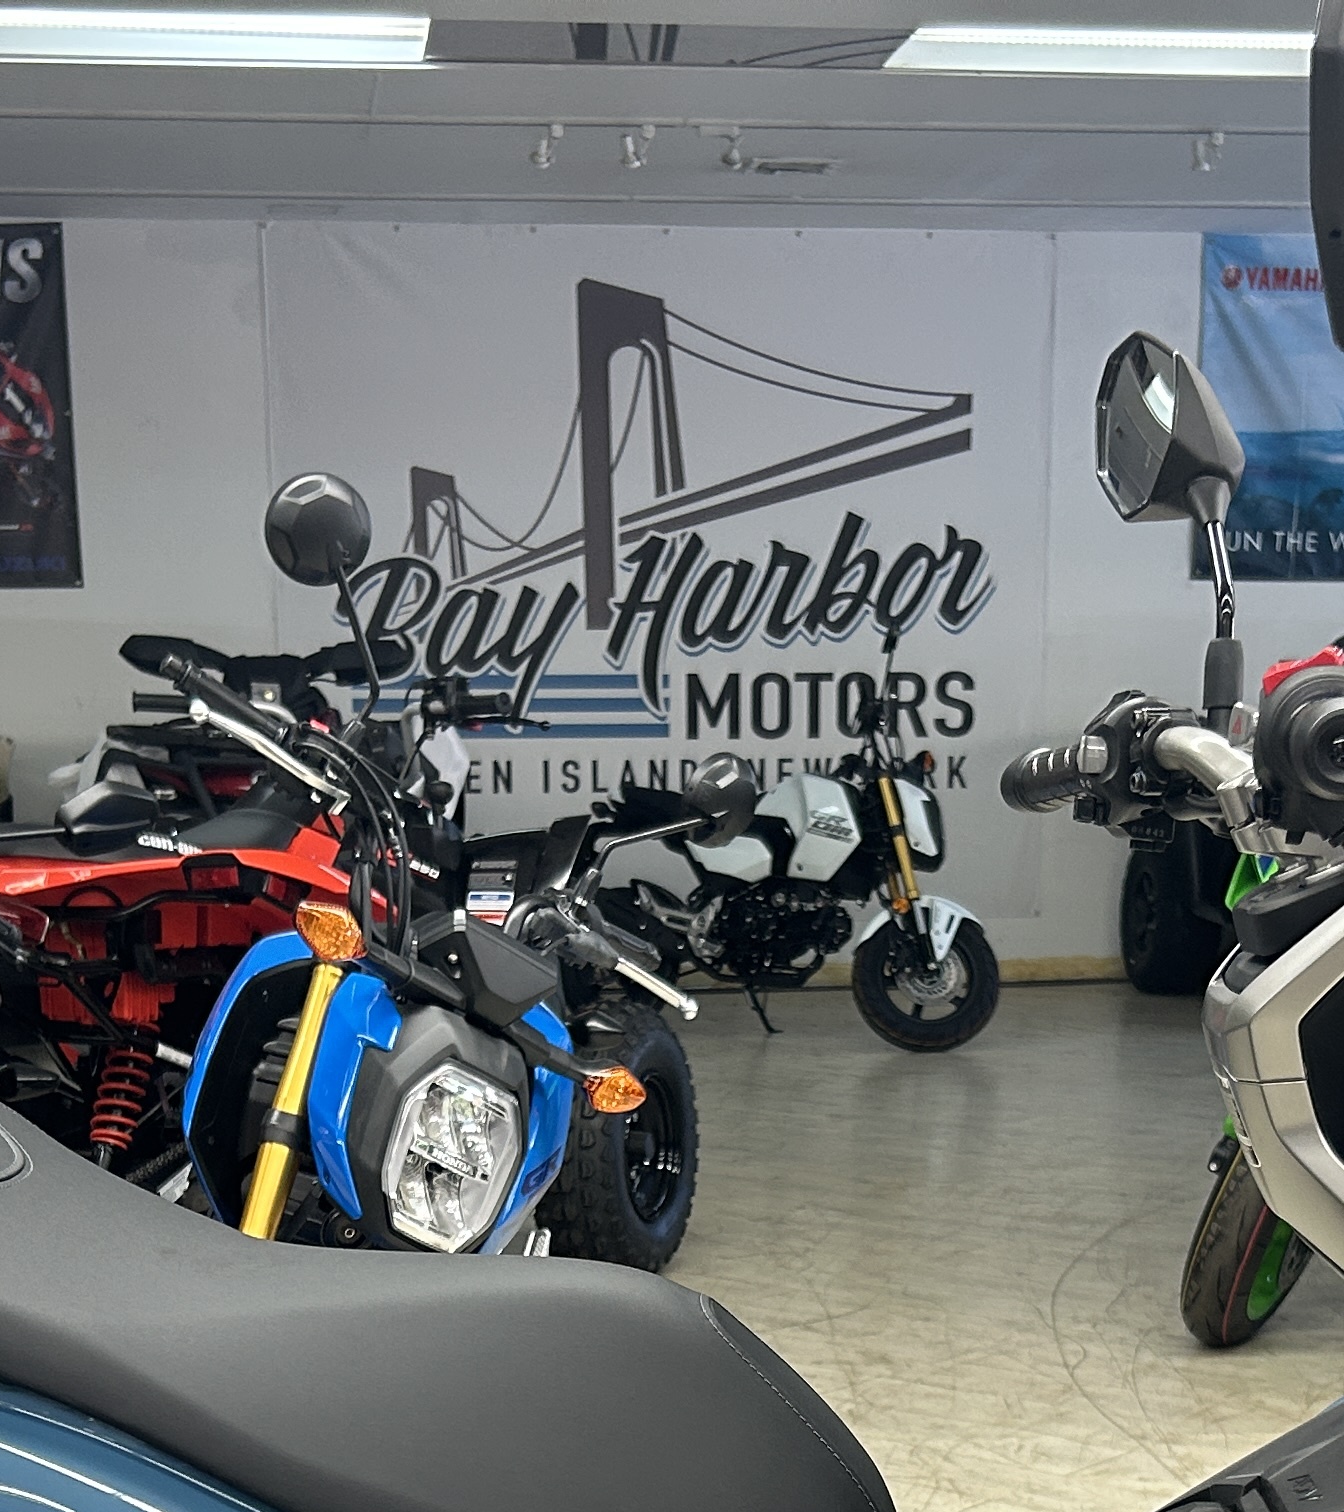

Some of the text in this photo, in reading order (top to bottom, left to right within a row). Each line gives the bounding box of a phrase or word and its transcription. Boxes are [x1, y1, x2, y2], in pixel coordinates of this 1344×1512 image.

[1246, 266, 1326, 292] YAMAH
[1224, 531, 1264, 552] UN
[1273, 530, 1320, 553] THE
[346, 510, 993, 730] Bay Harbor
[687, 672, 978, 740] MOTORS
